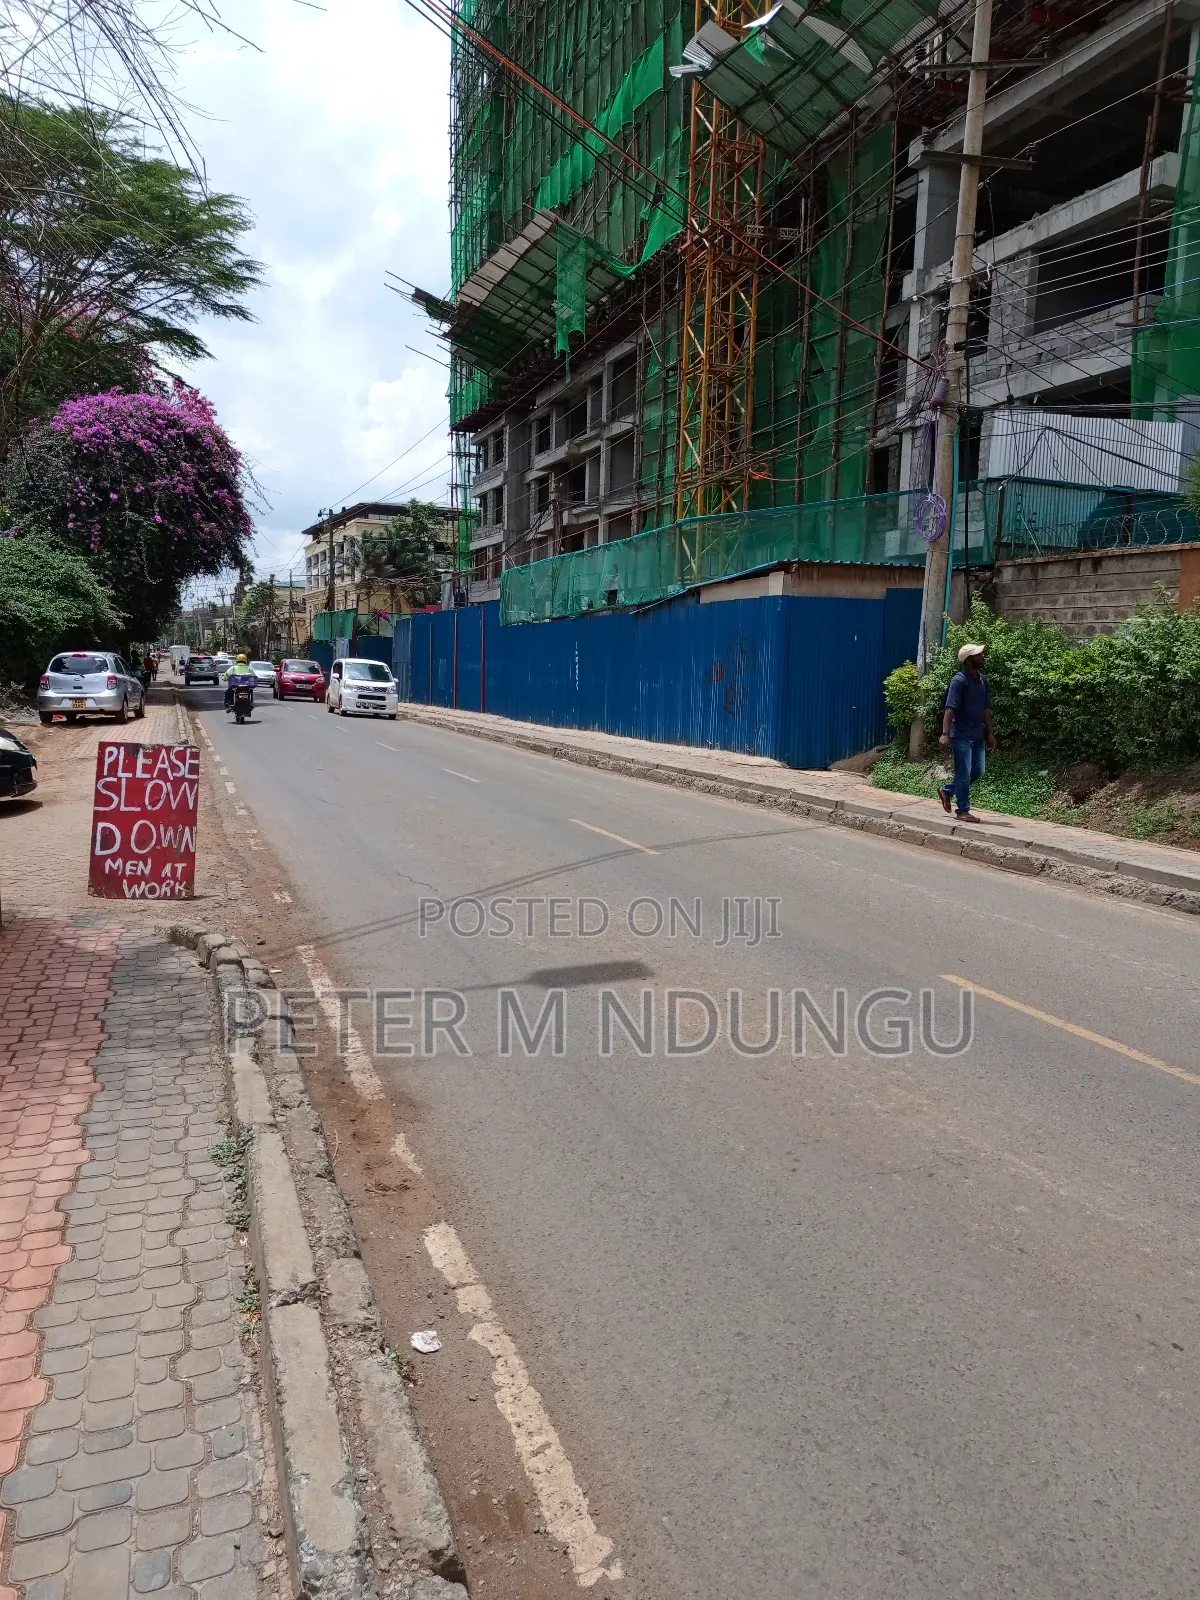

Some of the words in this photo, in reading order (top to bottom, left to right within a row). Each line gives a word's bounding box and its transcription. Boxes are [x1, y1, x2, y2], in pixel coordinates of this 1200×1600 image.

[103, 746, 199, 780] PLEASE
[94, 777, 198, 811] SLOW
[95, 820, 196, 856] DOWN
[104, 857, 152, 877] MEN
[161, 862, 187, 878] AT
[123, 879, 187, 899] WORK
